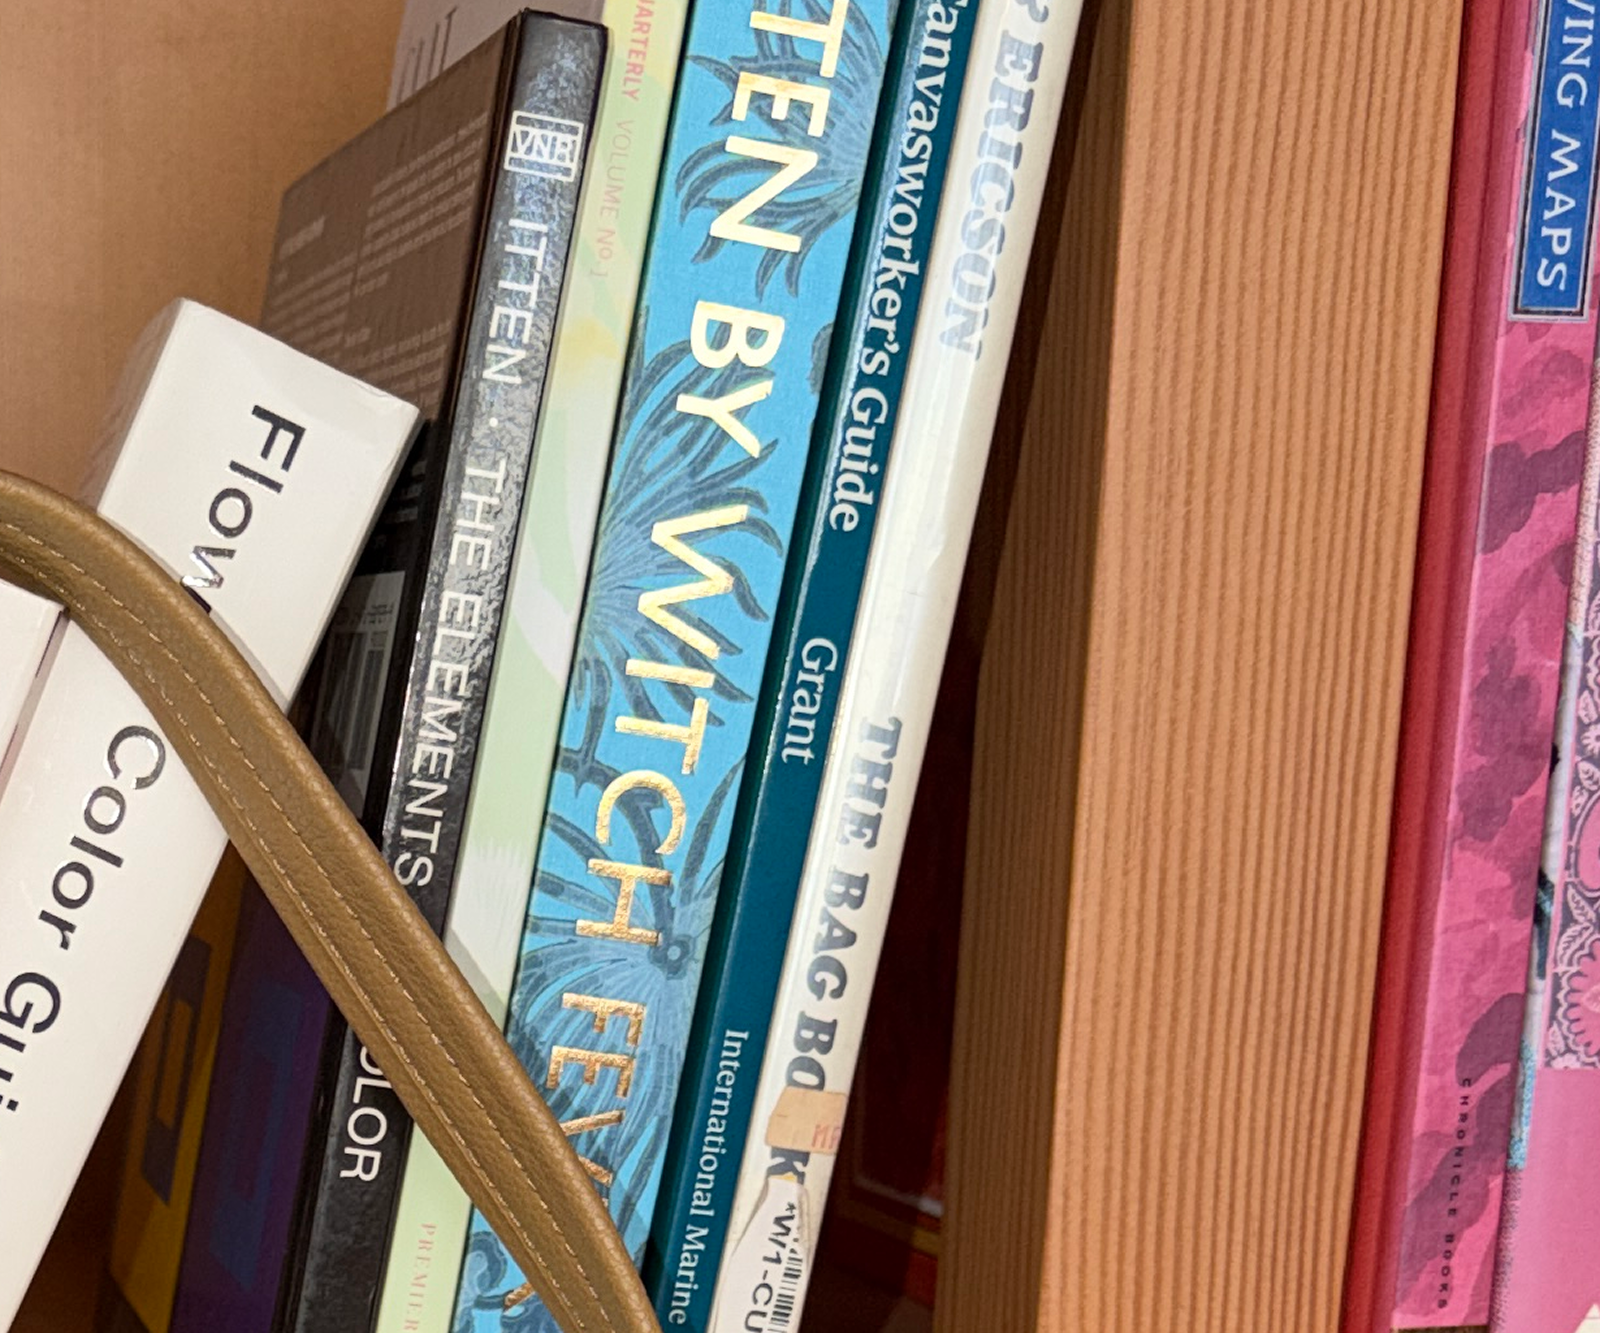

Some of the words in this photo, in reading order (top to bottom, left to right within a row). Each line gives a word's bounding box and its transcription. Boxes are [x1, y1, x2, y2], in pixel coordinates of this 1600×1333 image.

[621, 0, 654, 101] ARTERLY
[709, 0, 847, 253] TEN
[510, 129, 579, 166] VNR
[600, 120, 635, 219] VOLUME
[859, 0, 972, 376] anvasworker's
[939, 35, 1044, 361] ERICSON
[1537, 129, 1581, 291] MAPS
[483, 218, 548, 384] ITTEN
[676, 300, 785, 458] BY
[180, 404, 306, 613] Flow
[449, 452, 506, 571] THE
[830, 390, 888, 532] Guide
[399, 591, 484, 888] ELEMENTS
[575, 505, 748, 945] WITCH
[782, 637, 838, 765] Grant
[39, 724, 166, 950] Color
[837, 717, 902, 850] THE
[807, 867, 870, 1002] BAG
[687, 1029, 749, 1222] International
[766, 1011, 838, 1185] BOK
[1447, 1078, 1471, 1217] CHRONICLE
[669, 1225, 705, 1325] Marine
[1438, 1234, 1454, 1310] BOOKS
